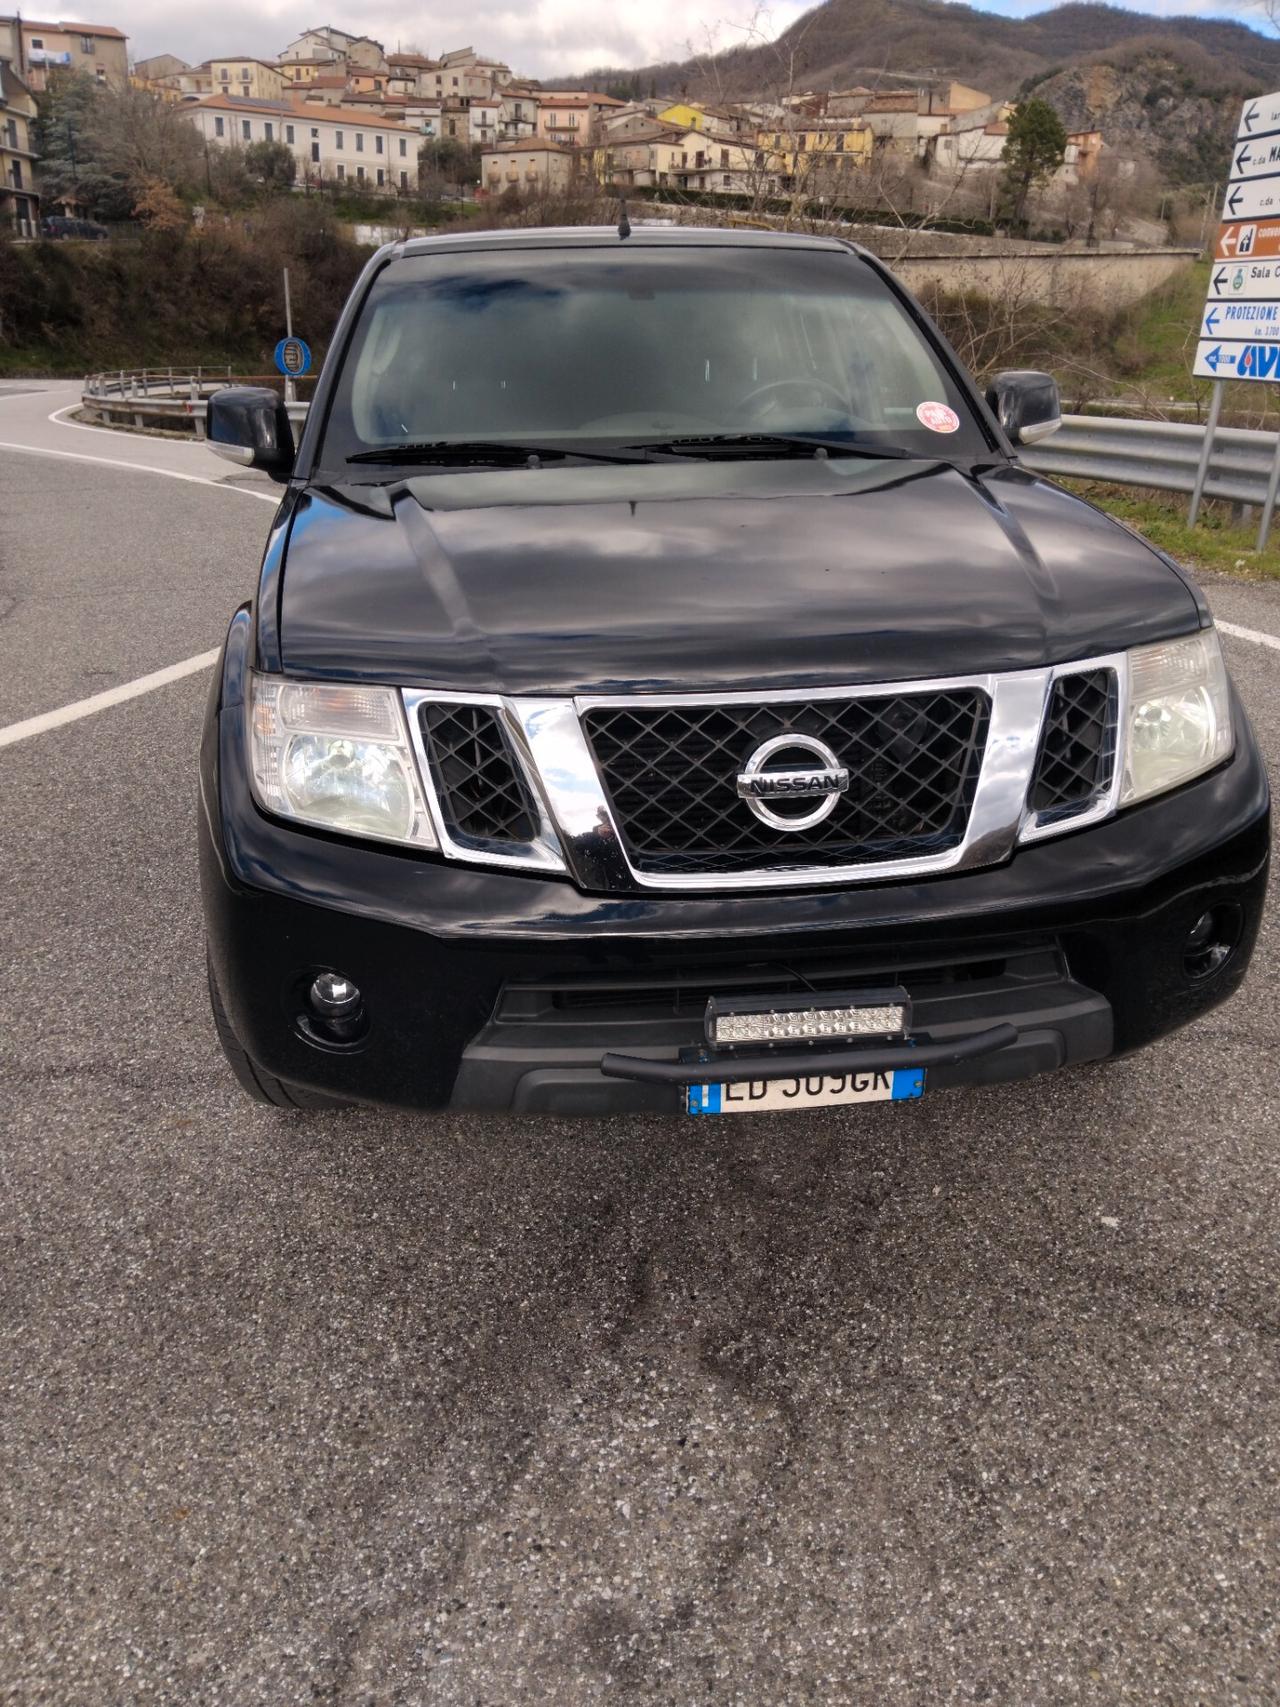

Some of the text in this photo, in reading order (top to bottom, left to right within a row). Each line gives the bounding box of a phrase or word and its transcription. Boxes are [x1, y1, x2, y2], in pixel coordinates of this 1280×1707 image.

[1251, 266, 1270, 278] Sala
[1225, 306, 1279, 320] PROTEZIONE
[750, 774, 840, 795] NISSAN
